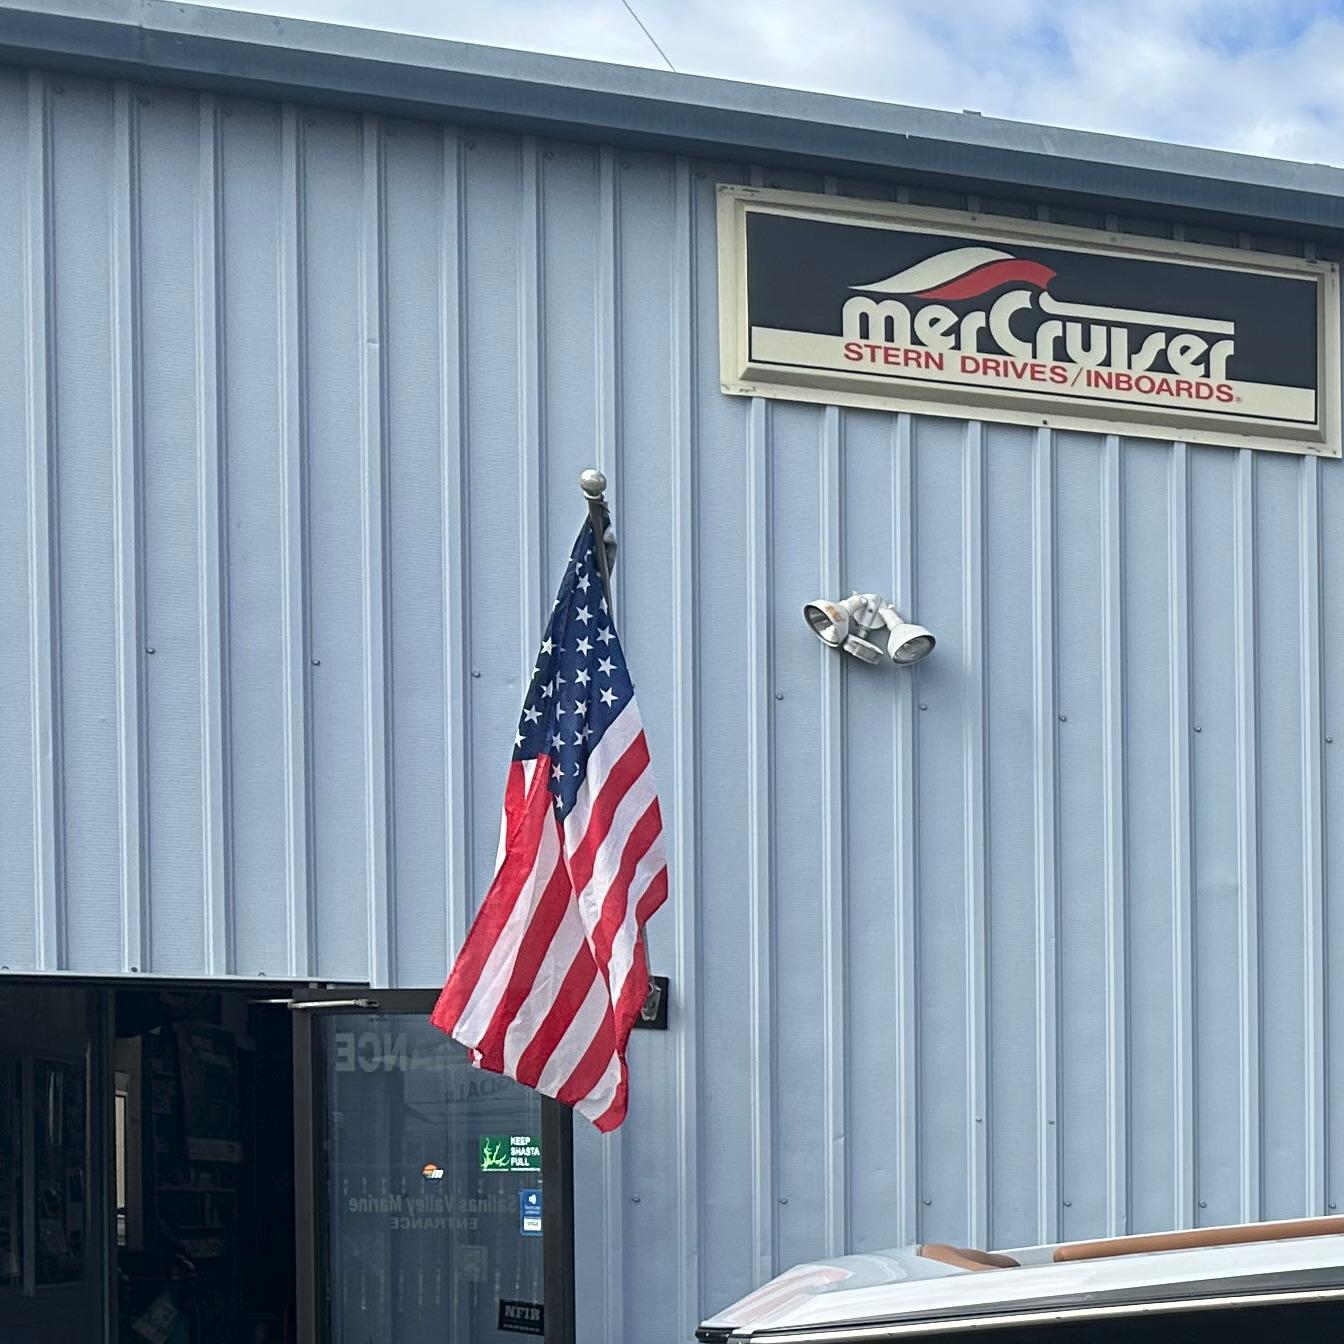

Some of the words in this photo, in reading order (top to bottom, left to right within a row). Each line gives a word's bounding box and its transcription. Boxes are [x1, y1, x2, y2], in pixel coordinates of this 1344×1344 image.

[843, 342, 945, 371] STERN
[960, 355, 1234, 403] DRIVES/INBOARDS
[510, 1136, 531, 1146] KEEP
[510, 1147, 540, 1156] SHASTA
[510, 1157, 530, 1166] FULL
